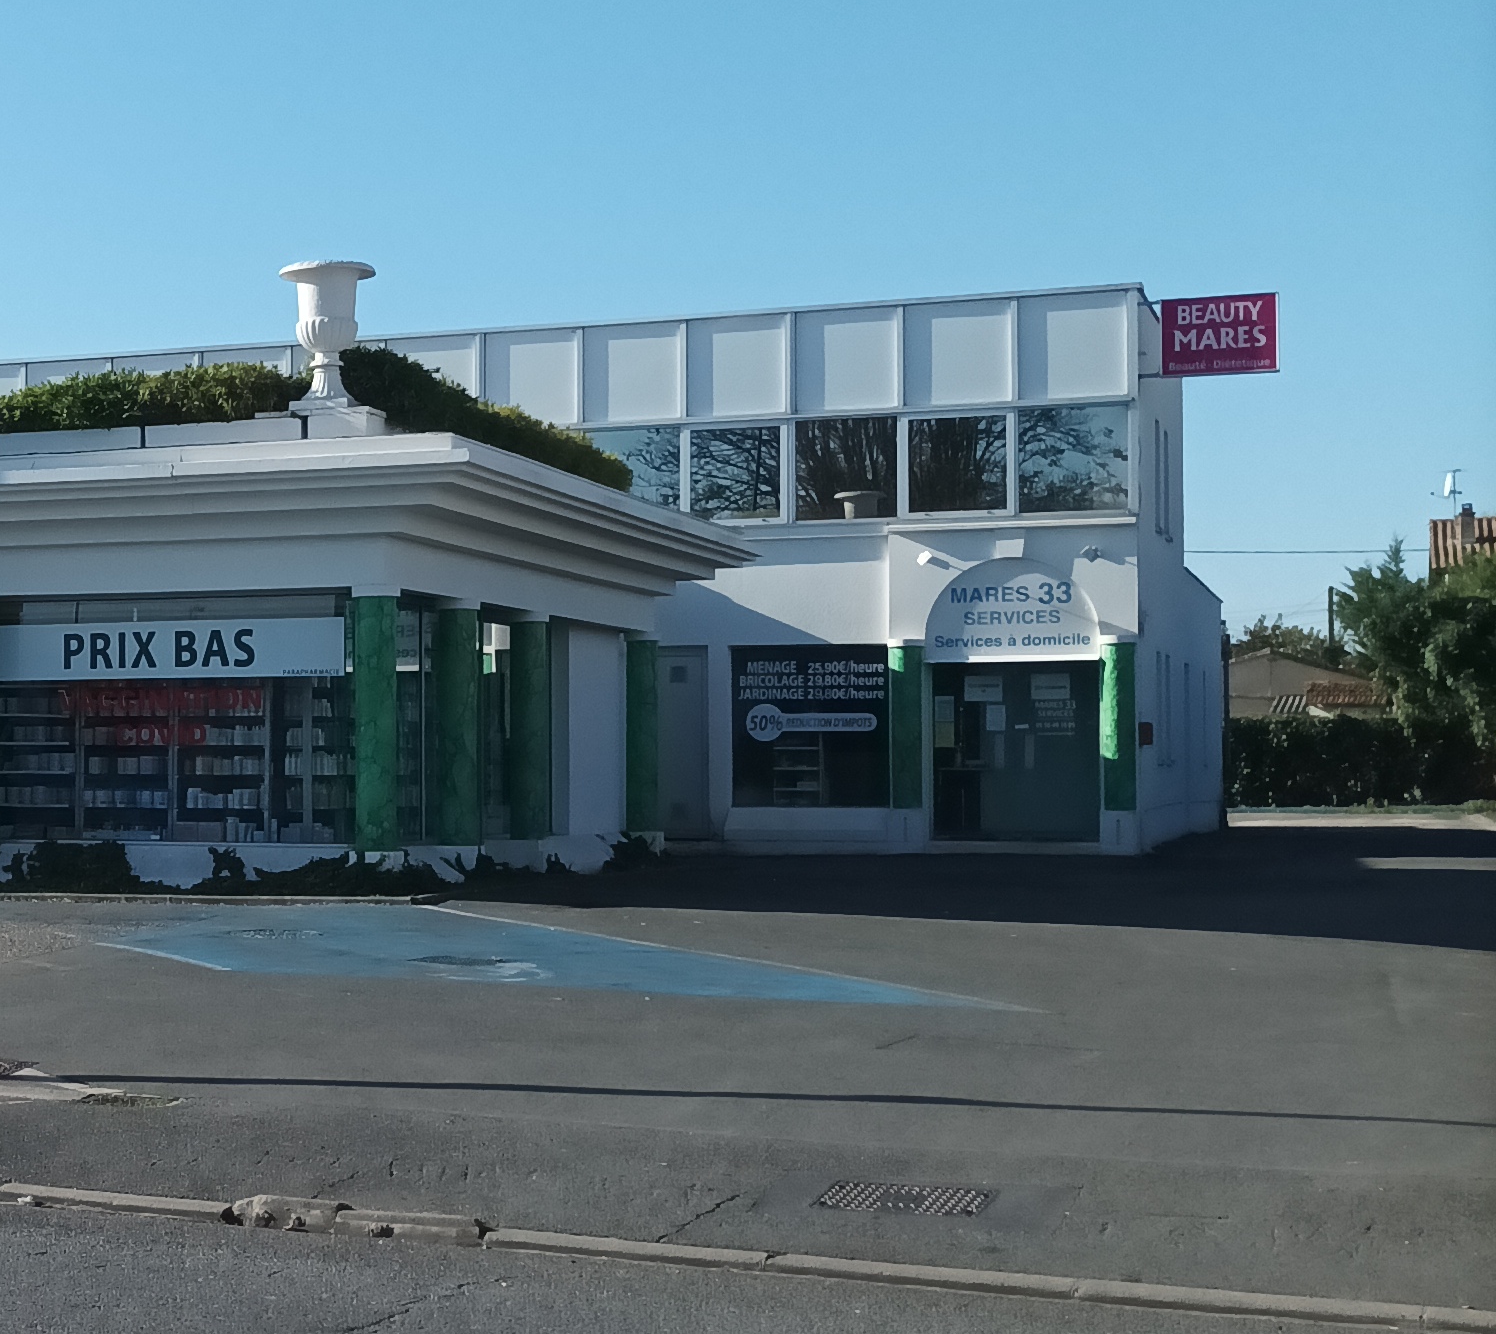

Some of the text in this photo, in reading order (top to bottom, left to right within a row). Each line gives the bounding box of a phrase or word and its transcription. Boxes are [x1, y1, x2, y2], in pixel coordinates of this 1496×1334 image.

[1177, 300, 1263, 325] BEAUTY
[1173, 325, 1267, 352] MARES
[1168, 360, 1206, 371] Beauté
[950, 581, 1072, 605] MARES 33
[963, 609, 1061, 626] SERVICES
[934, 633, 1091, 648] Services à domicile
[63, 629, 255, 670] PRIX BAS
[739, 675, 804, 687] BRICOLAGE
[738, 688, 805, 700] JARDINAGE
[748, 715, 783, 731] 50%
[115, 724, 207, 746] COVID
